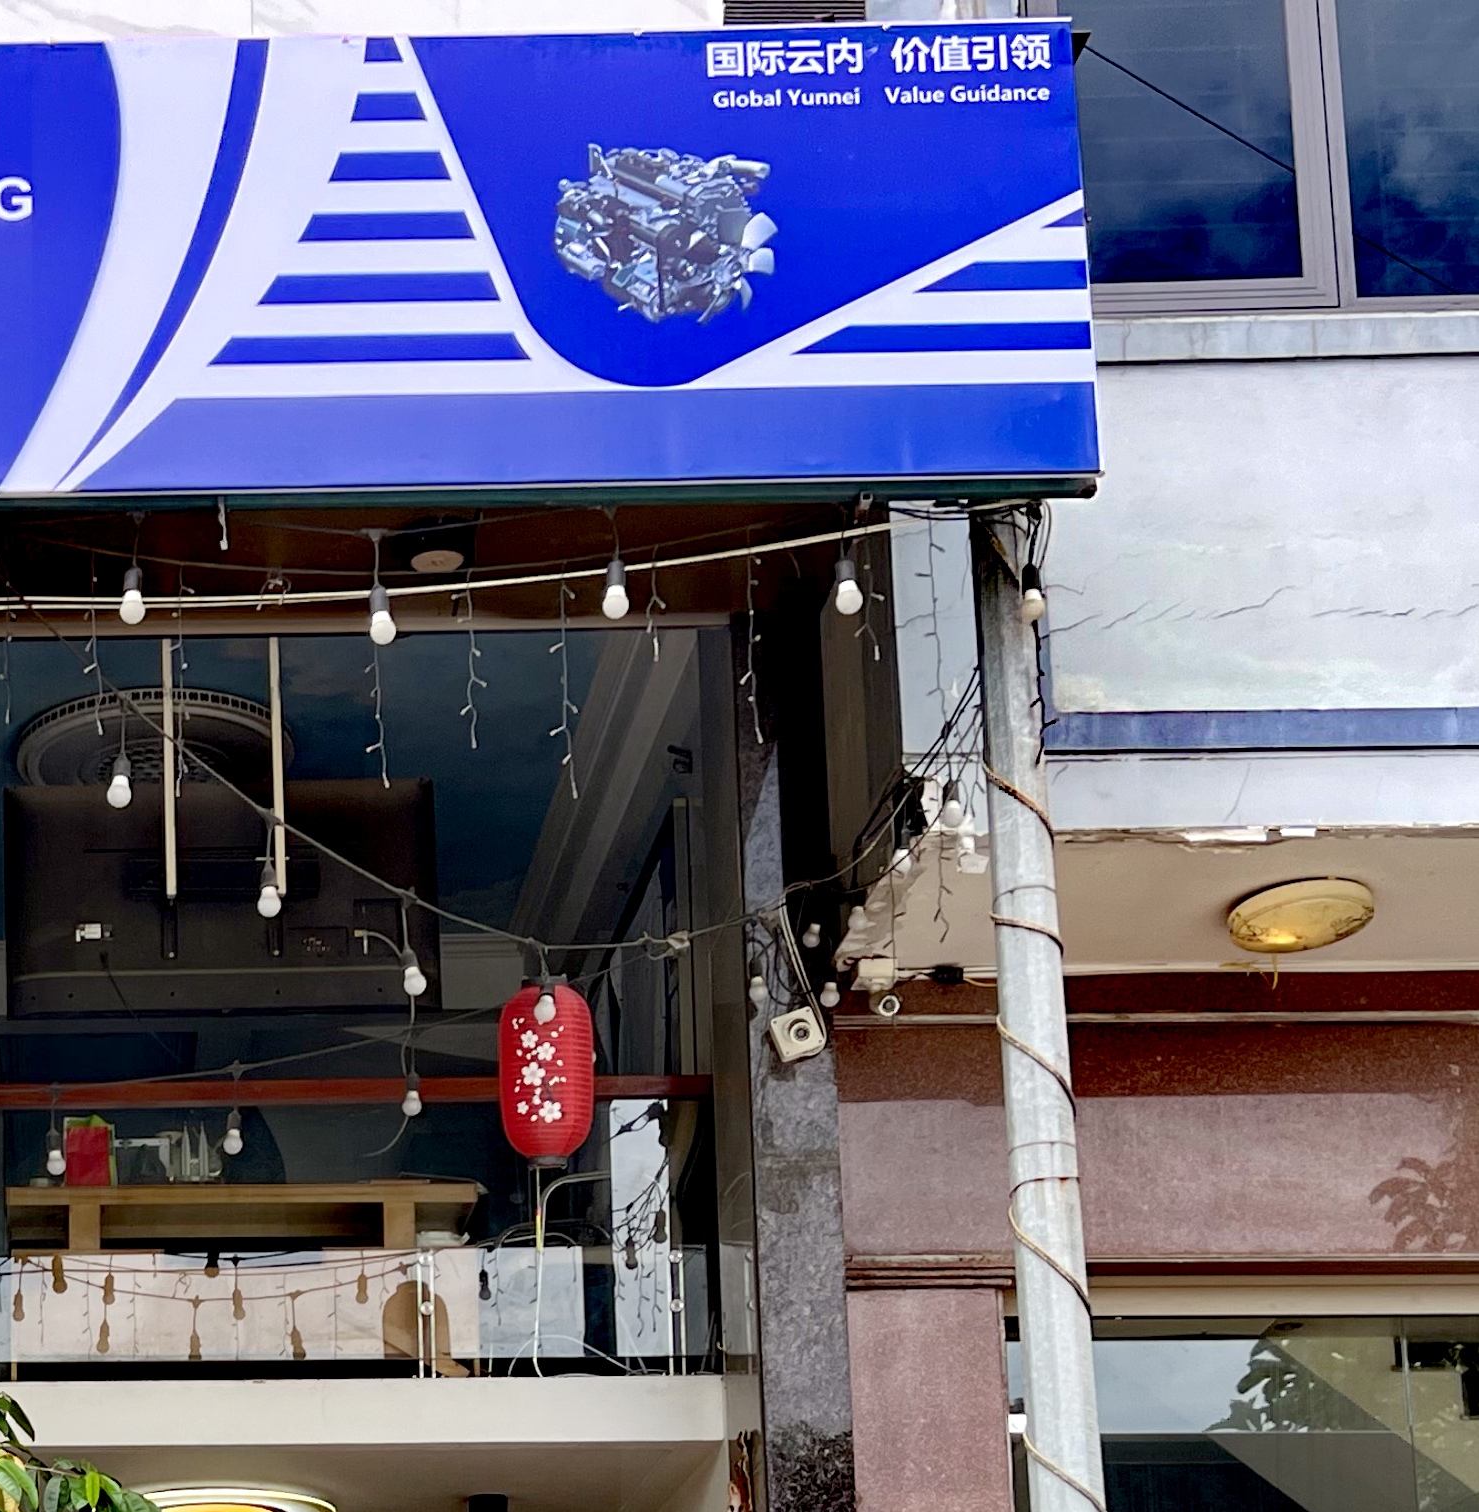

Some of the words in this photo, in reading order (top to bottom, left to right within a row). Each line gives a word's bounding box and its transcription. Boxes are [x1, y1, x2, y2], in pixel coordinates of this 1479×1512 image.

[706, 35, 864, 77] 国际云内
[891, 34, 1052, 73] 价值引领
[713, 89, 782, 109] Global
[788, 87, 860, 106] Yunnei
[885, 86, 945, 104] Value
[950, 85, 1051, 103] Guidance
